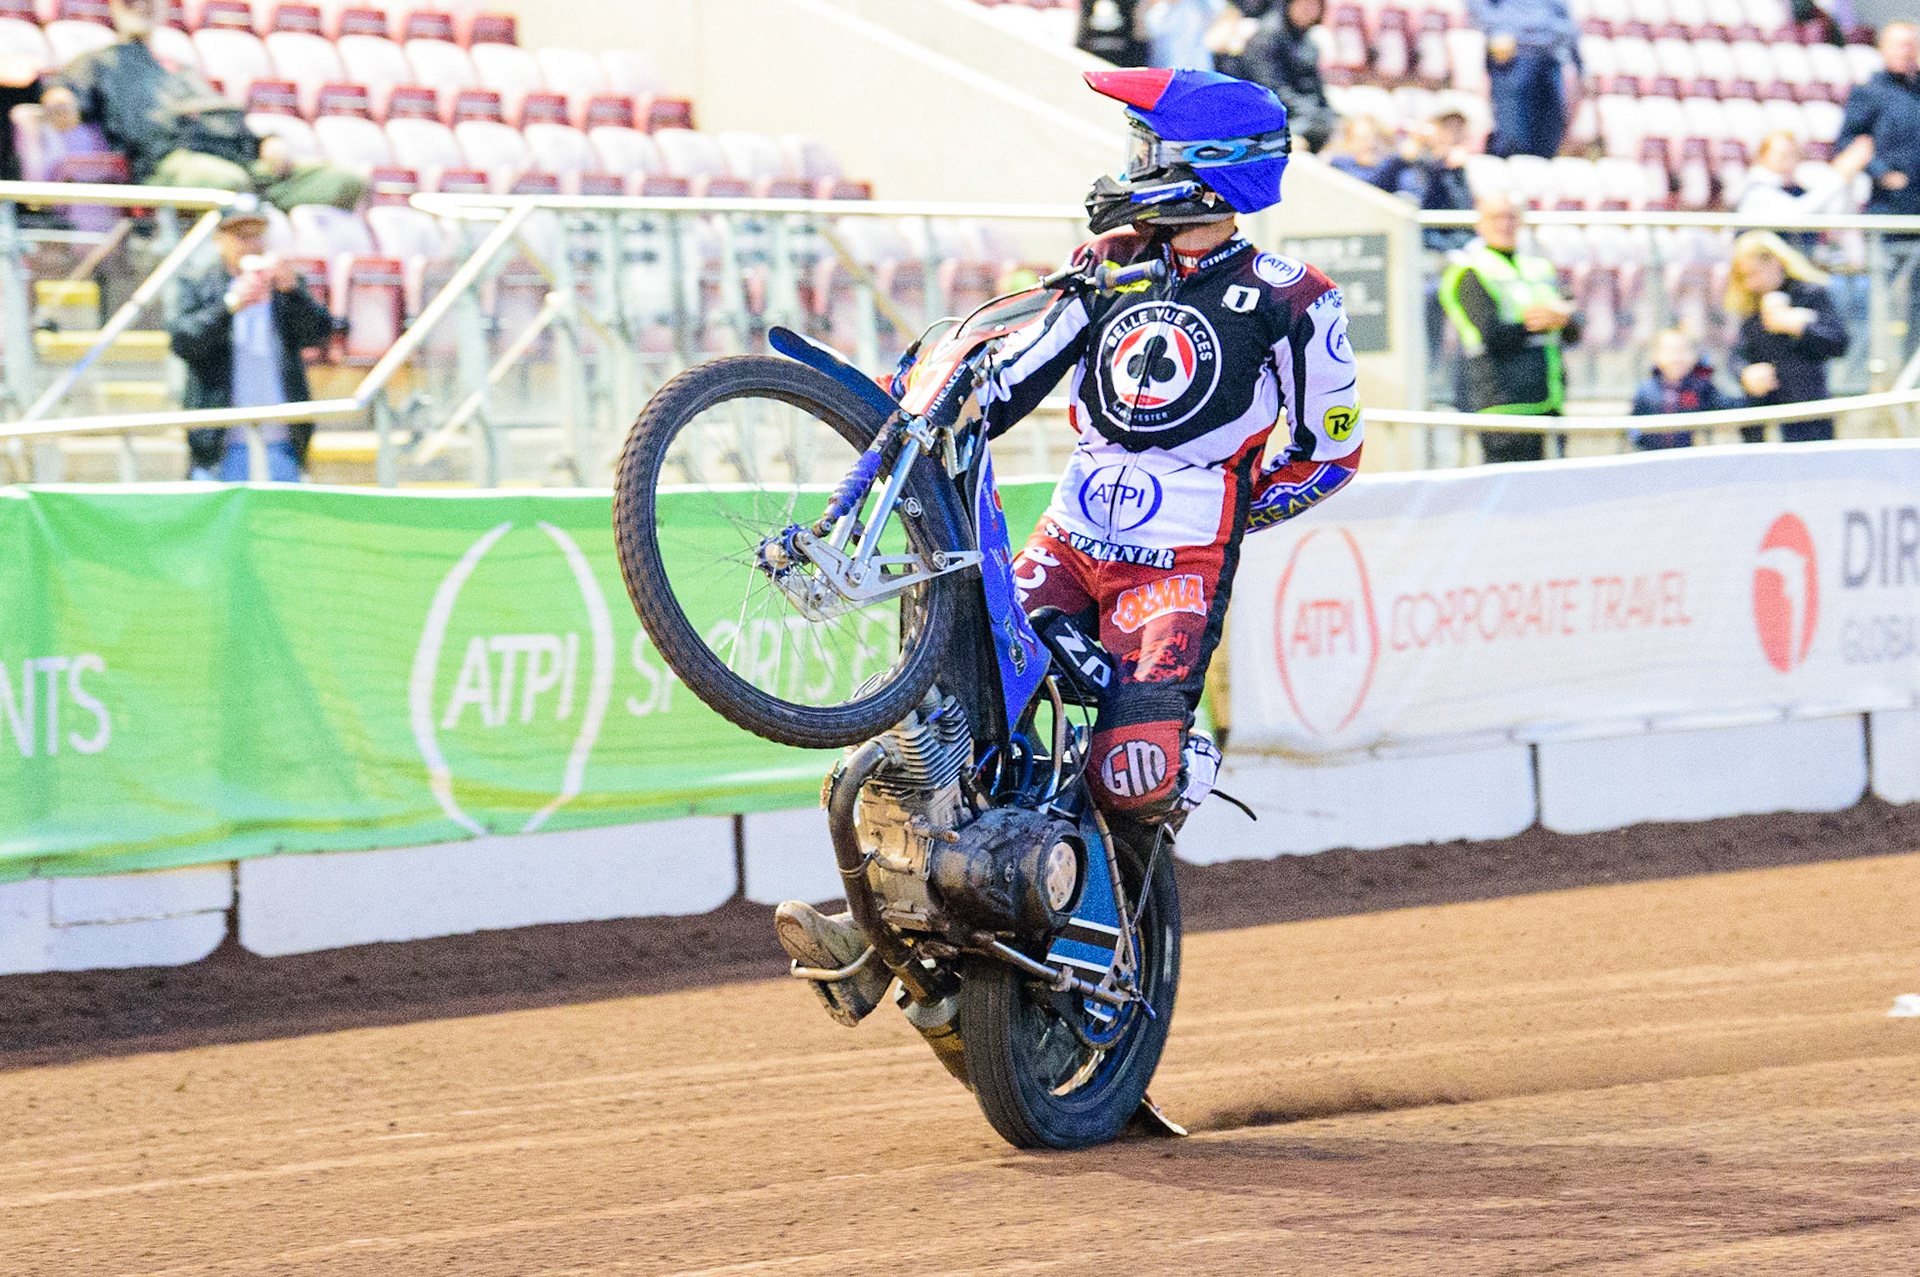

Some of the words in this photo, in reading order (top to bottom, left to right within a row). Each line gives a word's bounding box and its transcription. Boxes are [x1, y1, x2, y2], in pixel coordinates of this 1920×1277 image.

[1263, 257, 1296, 277] ATPI
[1235, 290, 1249, 309] 1
[1106, 310, 1149, 348] BELLE
[1155, 307, 1187, 326] VUE
[1185, 321, 1214, 362] ACES
[1112, 402, 1169, 422] MANESTER
[1088, 482, 1146, 509] ATPI
[1069, 531, 1177, 570] WARNER
[1289, 598, 1356, 658] ATPI
[1391, 577, 1580, 652] CORPORATE
[1588, 569, 1692, 632] TRAVEL
[441, 632, 579, 729] ATPI
[1101, 740, 1167, 797] GM
